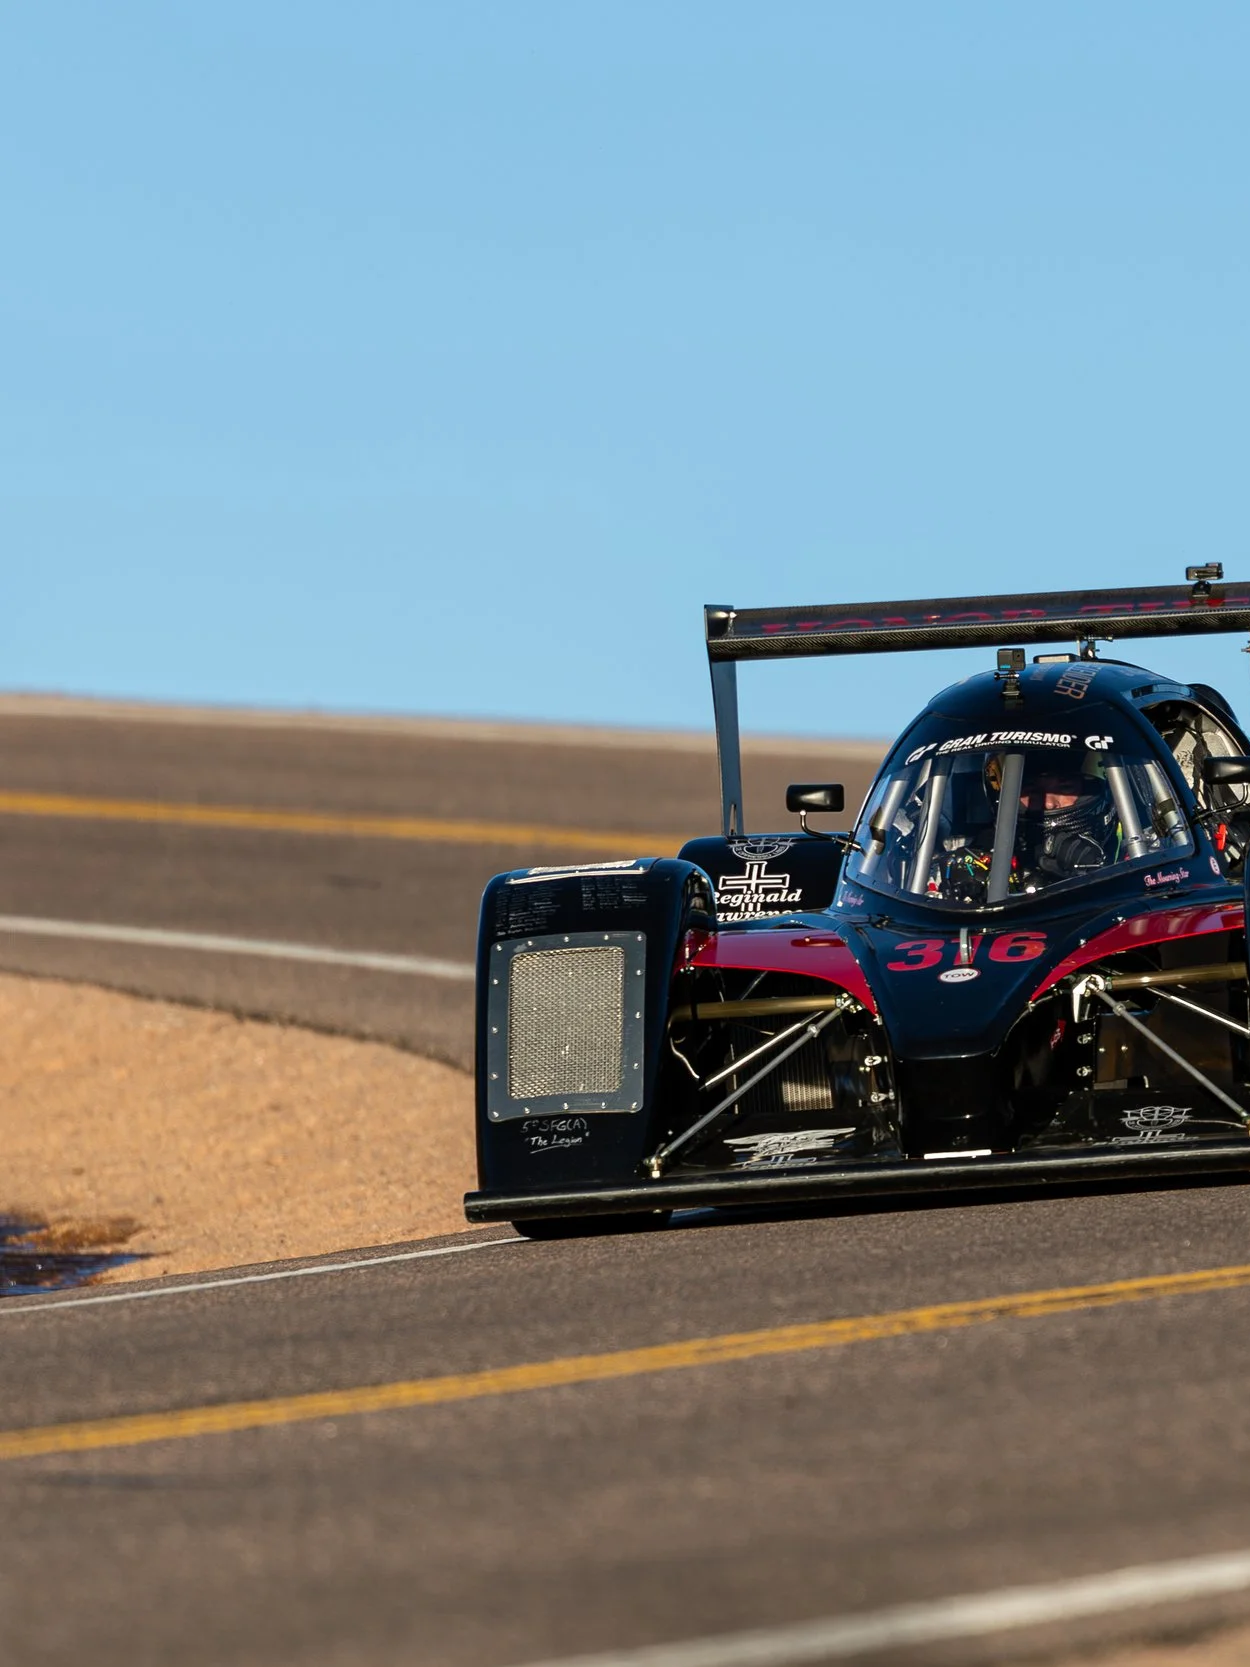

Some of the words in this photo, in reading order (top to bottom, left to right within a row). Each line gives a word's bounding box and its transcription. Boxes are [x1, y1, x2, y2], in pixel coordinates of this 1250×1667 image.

[938, 733, 988, 752] GRAN
[975, 740, 1012, 748] DRIVING
[1013, 739, 1071, 749] SIMULATOR
[887, 931, 1047, 971] 316
